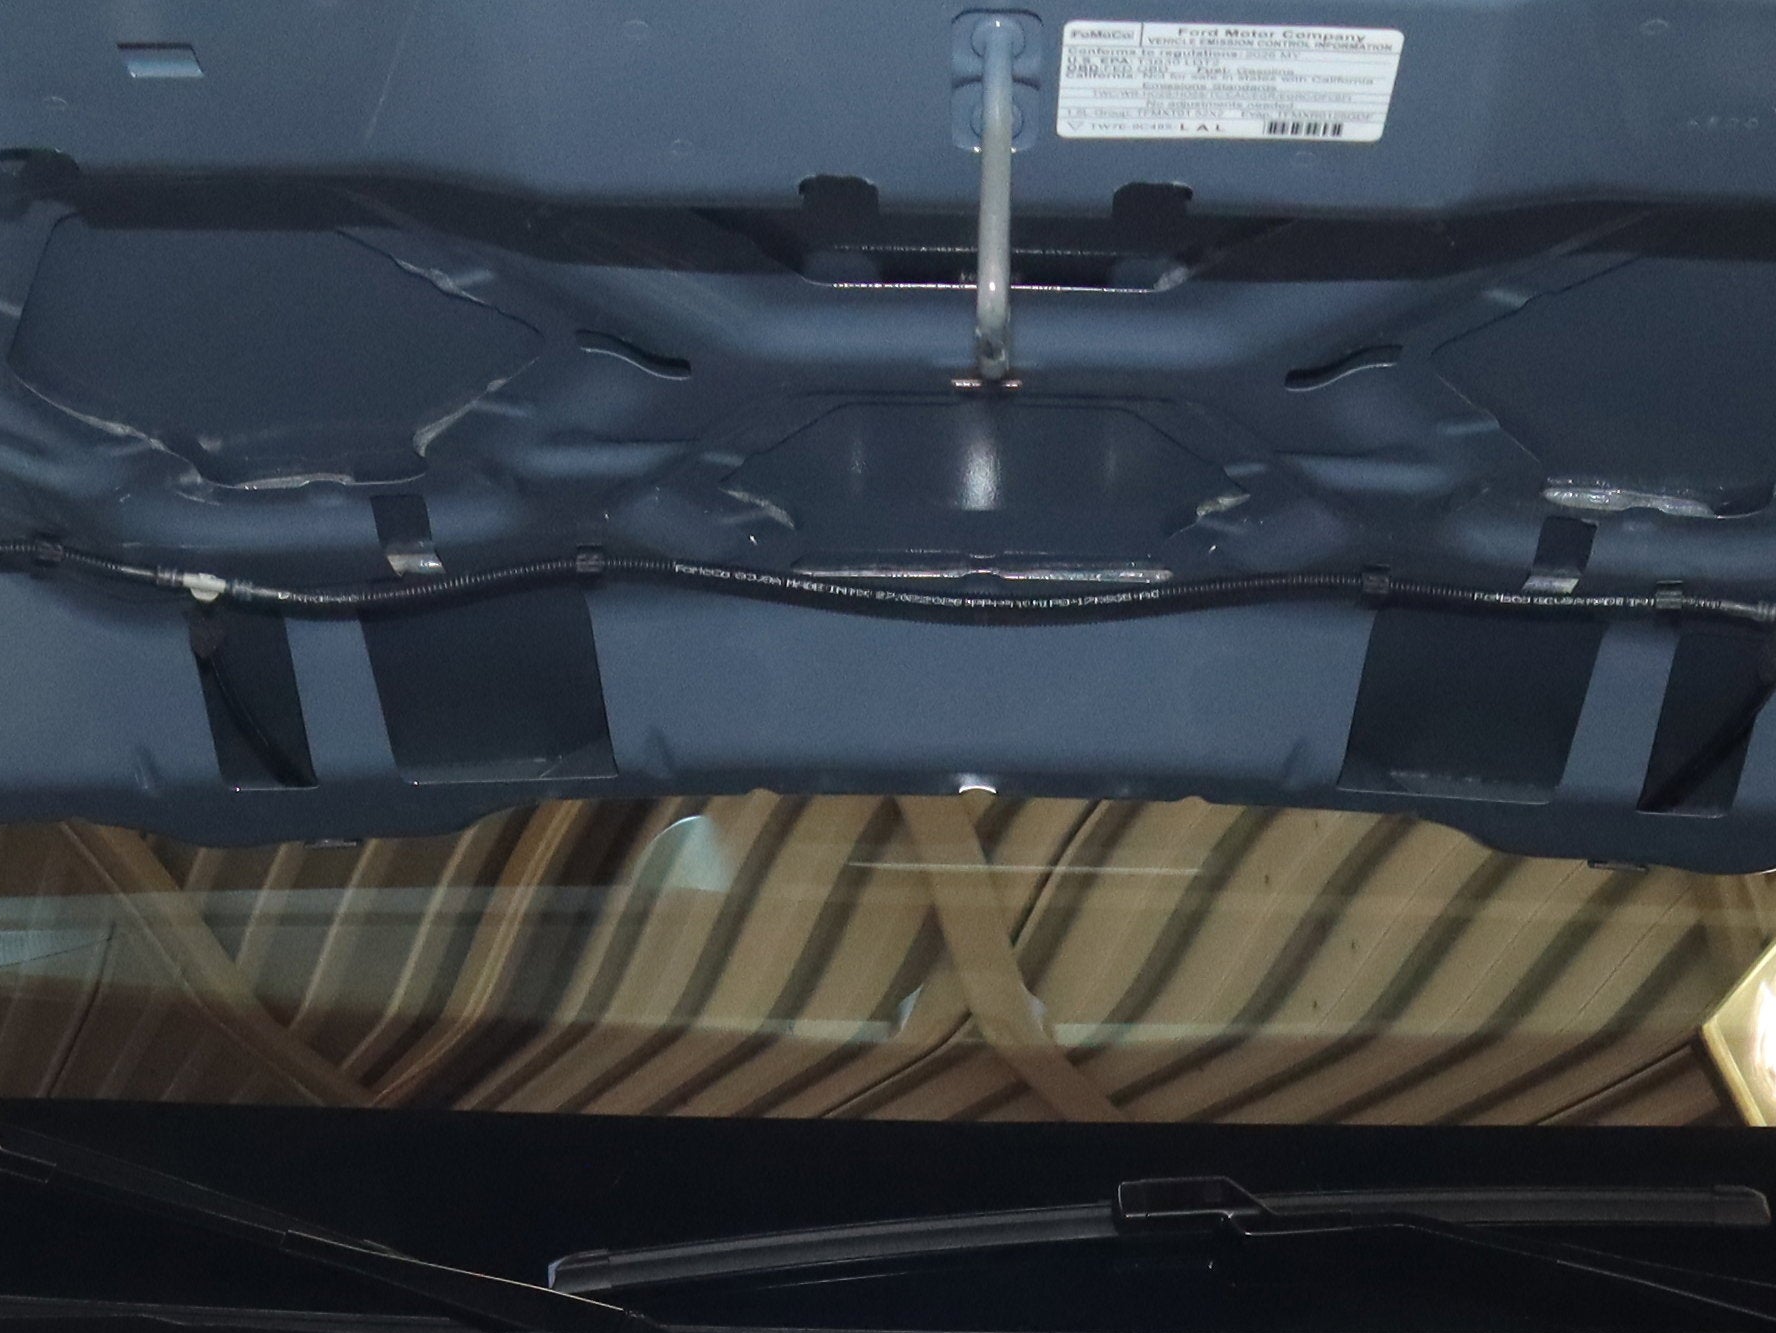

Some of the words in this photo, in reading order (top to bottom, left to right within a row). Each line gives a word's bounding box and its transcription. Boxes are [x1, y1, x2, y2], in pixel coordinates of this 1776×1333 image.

[1178, 28, 1218, 37] Ford
[1225, 29, 1275, 39] Motor
[1282, 30, 1366, 43] Company
[1147, 37, 1197, 45] VEHICLE
[1199, 38, 1254, 47] EMISSION
[1257, 40, 1309, 49] CONTROL
[1314, 41, 1393, 51] INFORMATION
